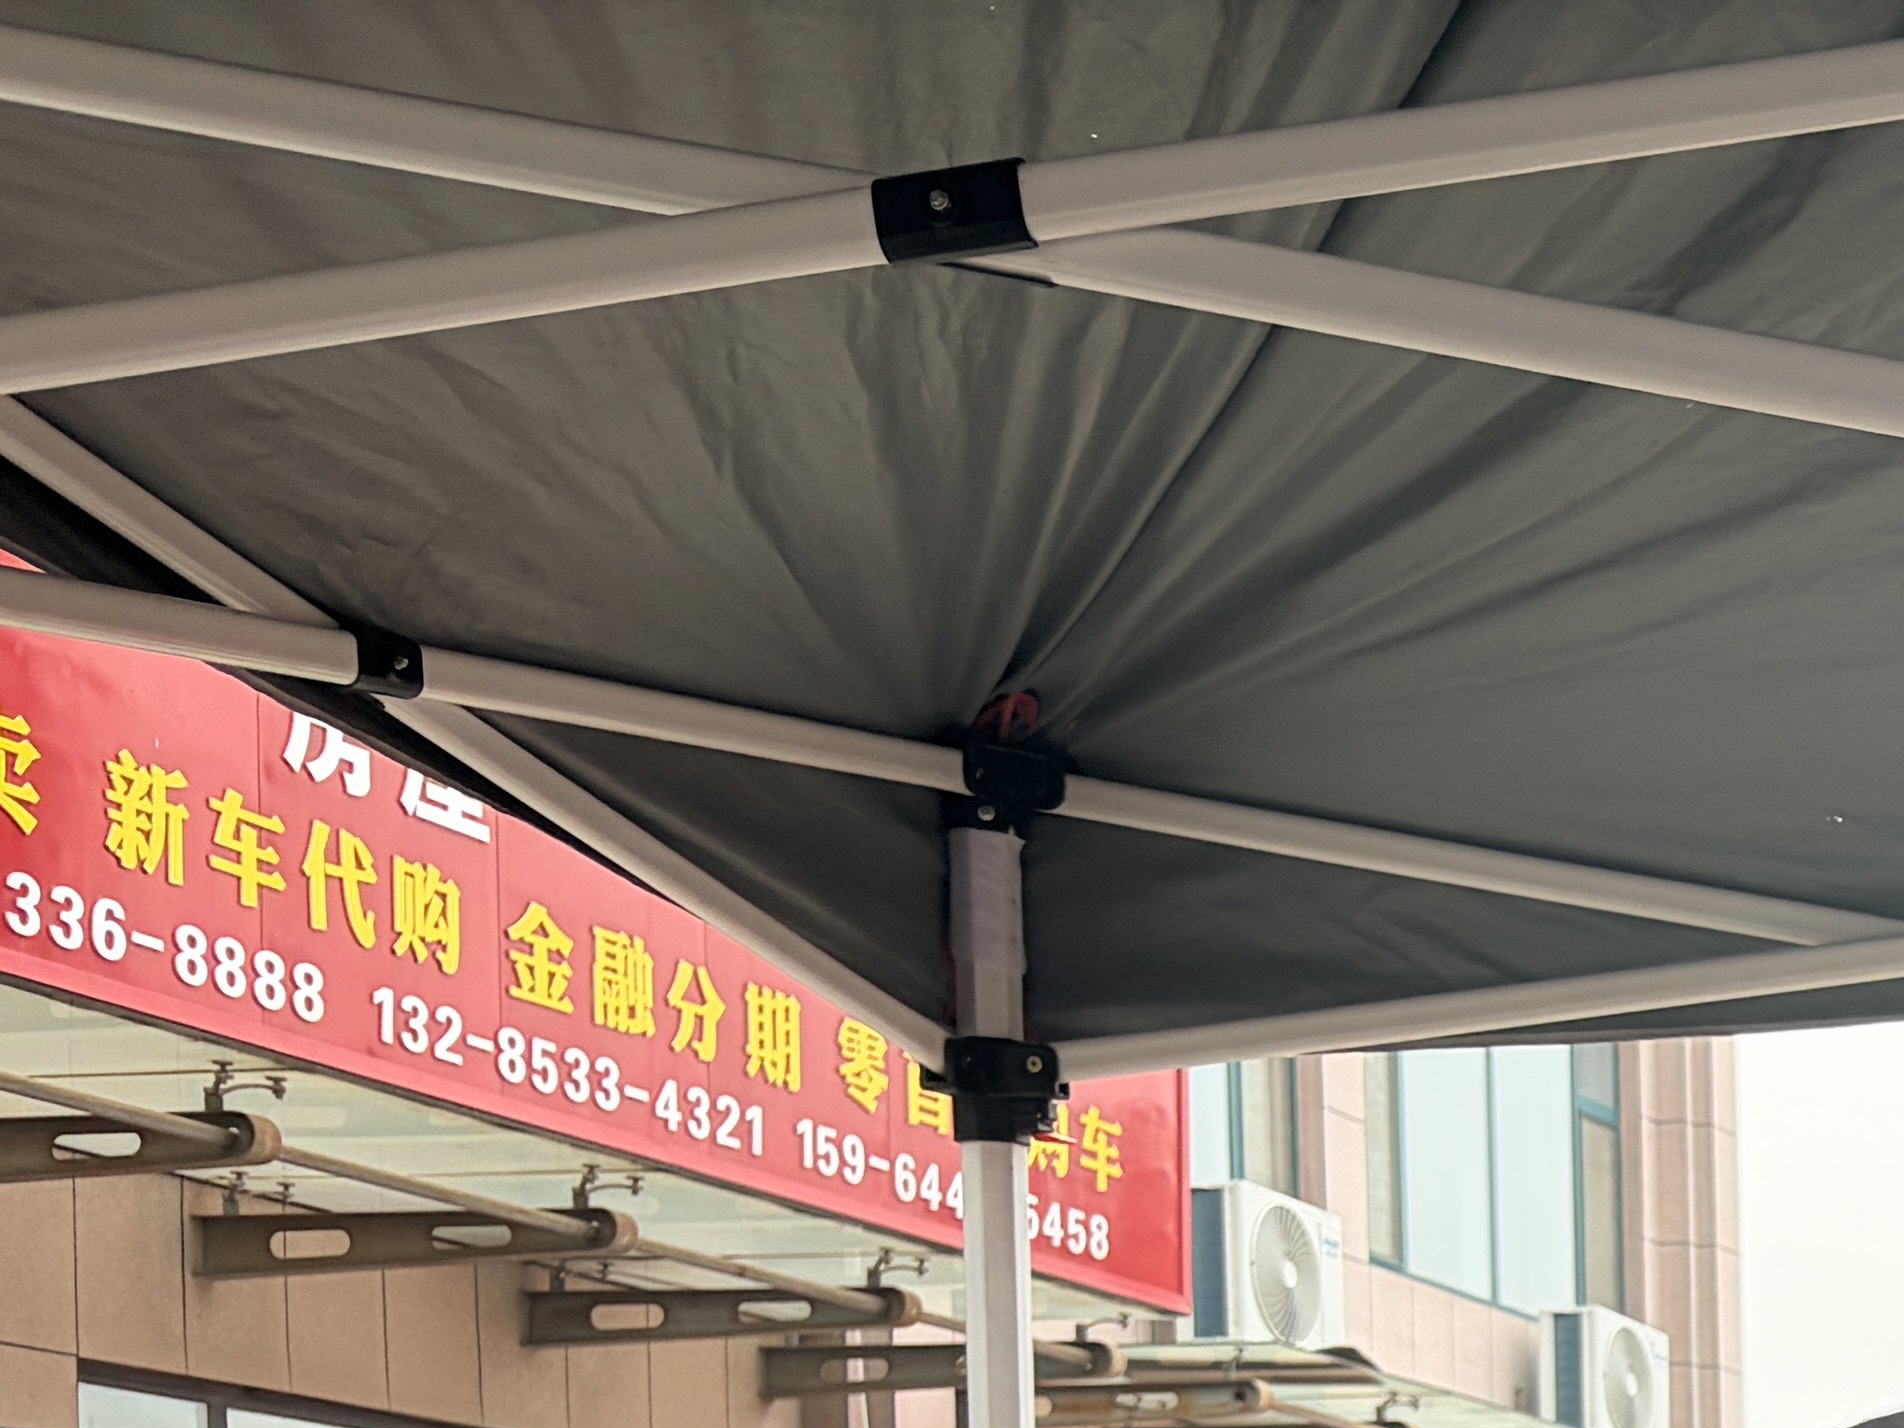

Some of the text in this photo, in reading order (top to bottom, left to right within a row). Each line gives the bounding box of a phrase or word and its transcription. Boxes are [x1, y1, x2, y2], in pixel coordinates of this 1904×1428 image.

[3, 871, 1110, 1261] 336-8888 132-8533-4321 159-6445458
[104, 747, 462, 977] 新车代购
[506, 900, 802, 1093] 金融分期
[836, 1016, 1124, 1193] 零首购车
